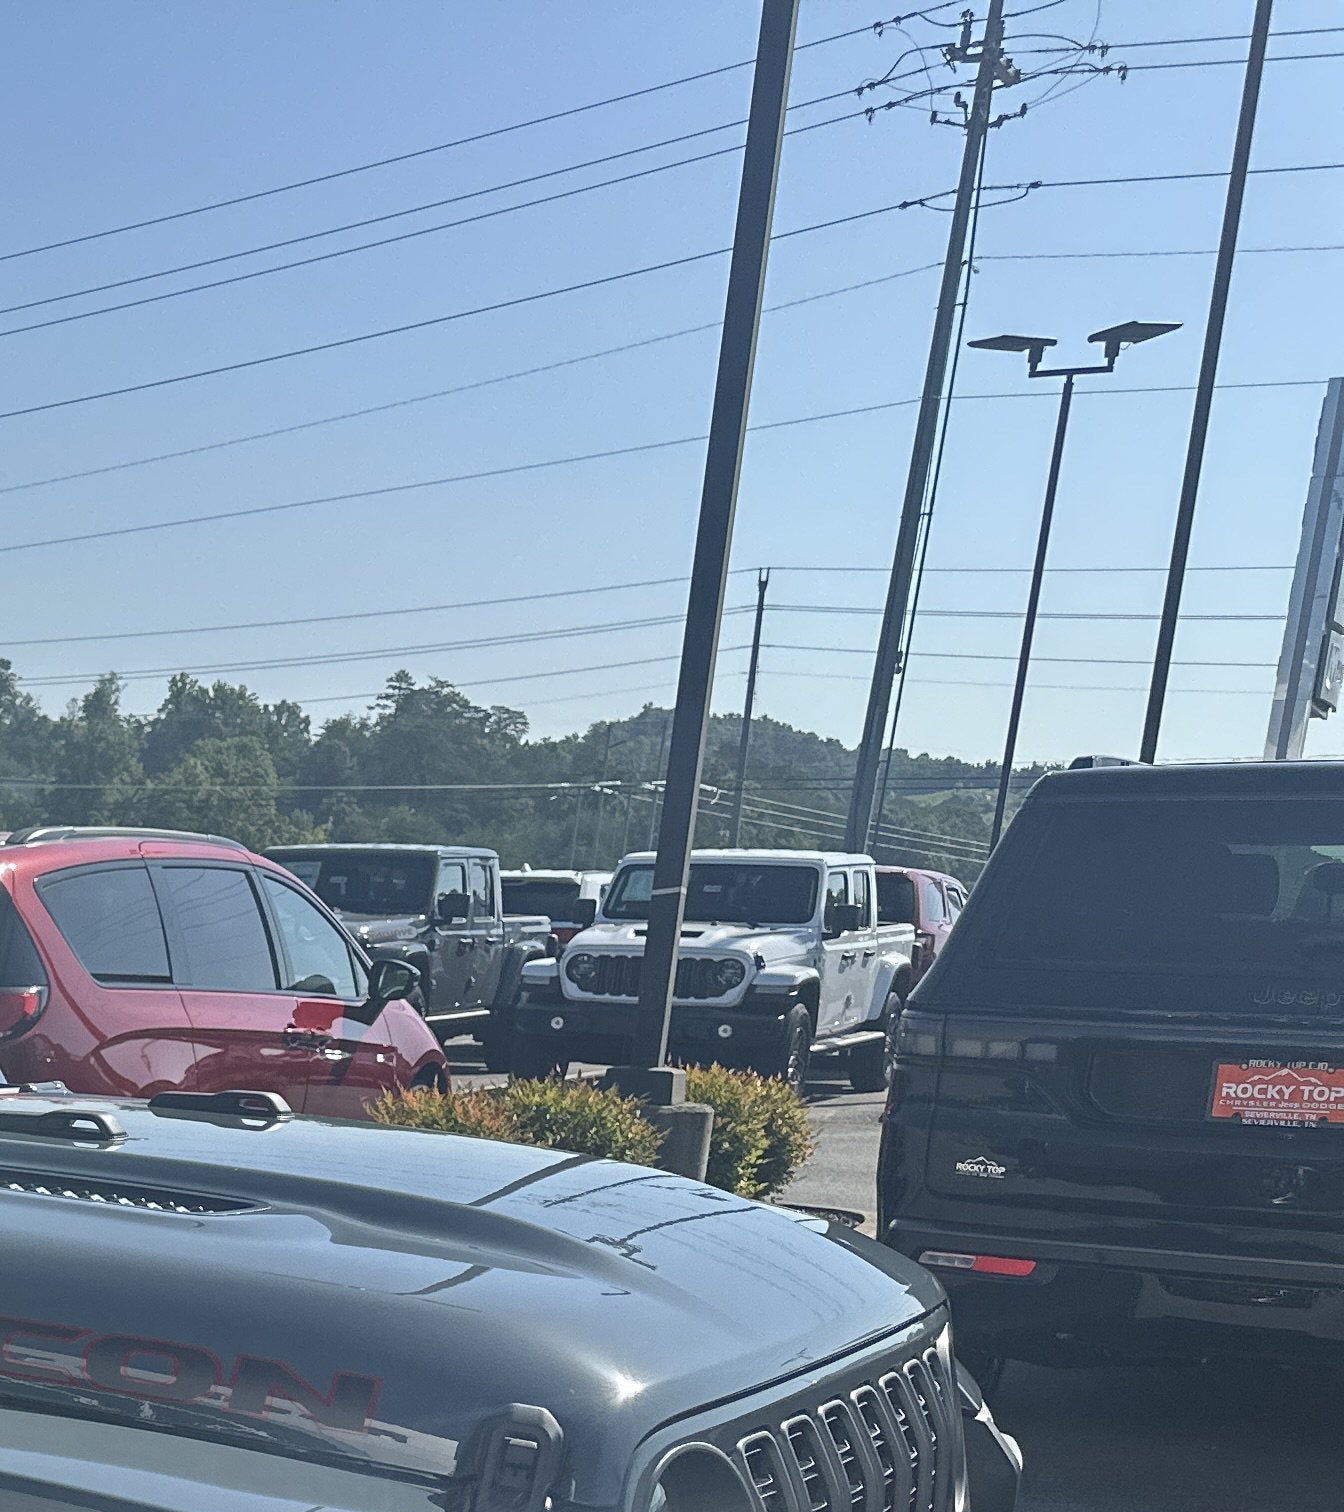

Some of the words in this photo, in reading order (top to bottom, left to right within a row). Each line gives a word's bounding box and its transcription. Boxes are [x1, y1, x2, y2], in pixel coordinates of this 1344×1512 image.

[1221, 1082, 1297, 1100] ROCKY
[1299, 1085, 1344, 1102] TOP
[1219, 1099, 1277, 1108] CHRYSLER
[1278, 1101, 1301, 1109] Jeep
[1302, 1102, 1344, 1110] DODGE
[1304, 1113, 1317, 1121] TN
[955, 1162, 986, 1172] ROCKY
[987, 1165, 1006, 1174] TOP
